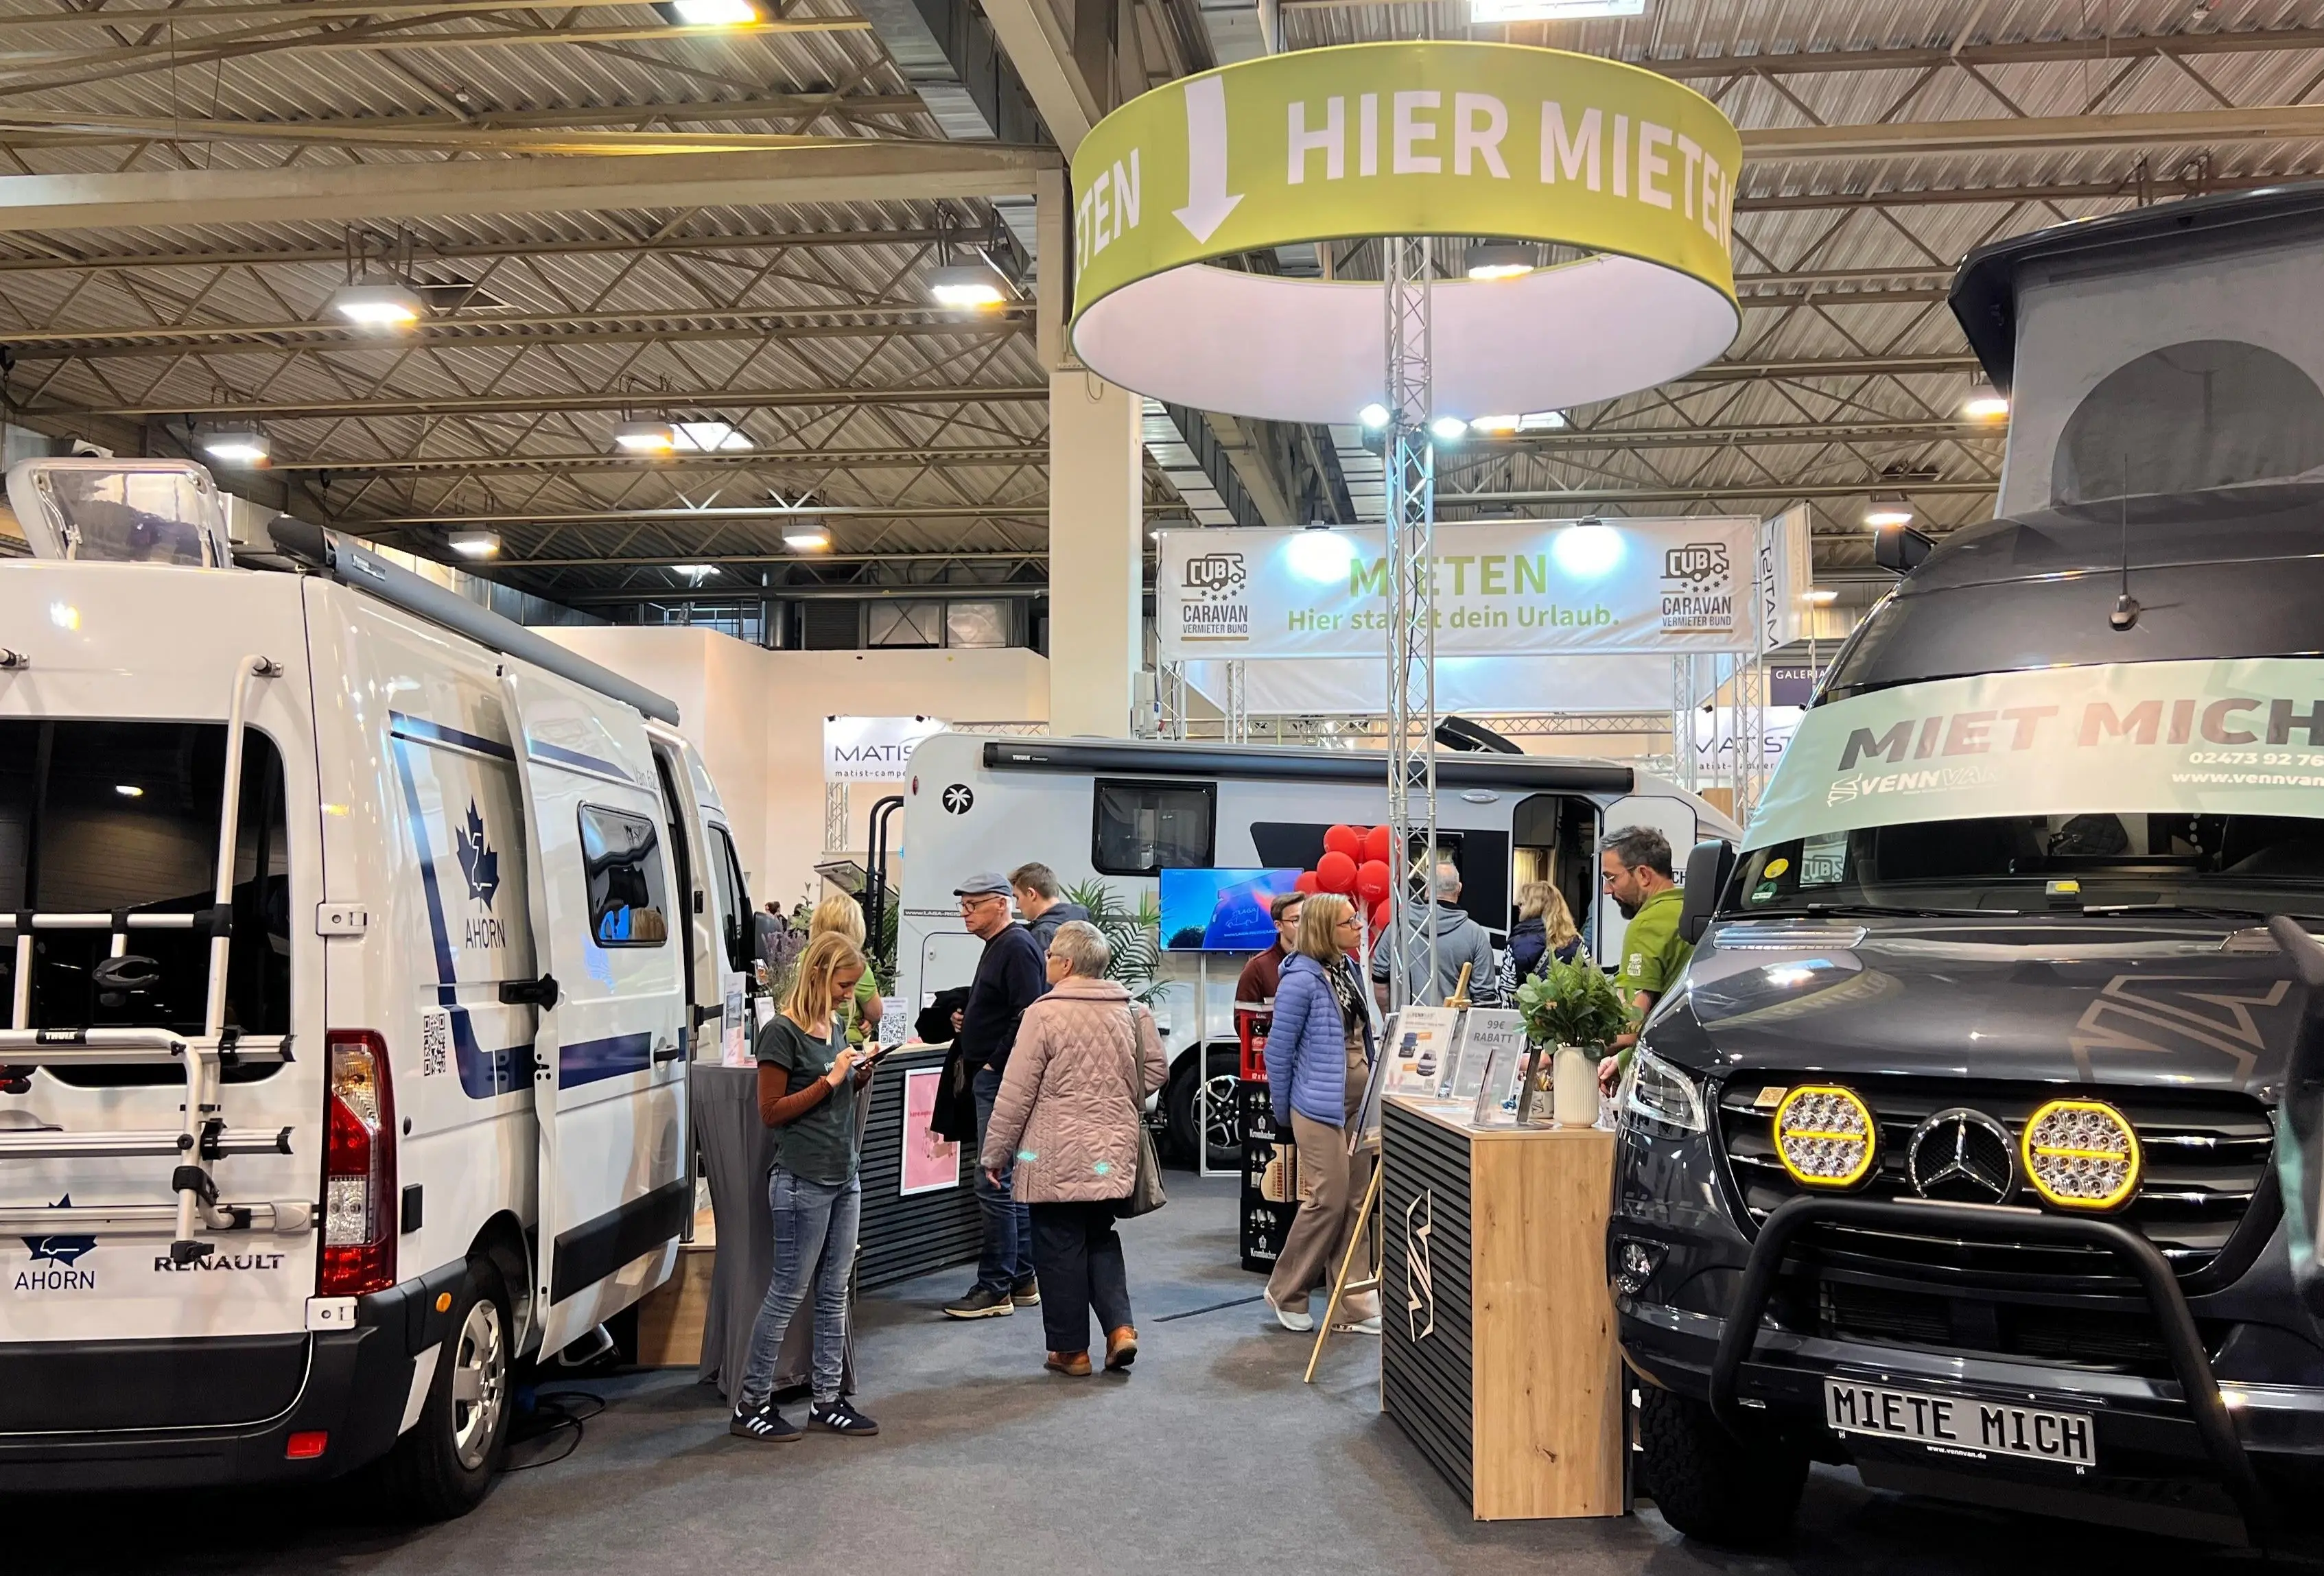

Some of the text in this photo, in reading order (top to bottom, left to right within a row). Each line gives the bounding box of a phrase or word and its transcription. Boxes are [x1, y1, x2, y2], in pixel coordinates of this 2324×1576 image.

[1287, 91, 1733, 258] HIER MIETEN
[1350, 555, 1546, 597] METEN
[1183, 604, 1247, 622] CARAVAN
[1663, 596, 1731, 615] CARAVAN
[1289, 603, 1619, 631] Hier statet dein Urlaub.
[1663, 615, 1731, 626] VERMIETER BUND
[1183, 624, 1247, 633] VERMIETER BUND
[1776, 670, 1826, 679] GALERIA
[1838, 698, 2324, 771] MIET MICH
[2189, 752, 2324, 767] 02473 92 76
[2172, 773, 2324, 787] www.vennvan
[466, 918, 506, 949] AHORN
[1487, 1020, 1506, 1030] 99€
[1473, 1032, 1514, 1044] RABATT
[14, 1270, 95, 1291] AHORN
[1833, 1384, 2088, 1459] MIETE MICH
